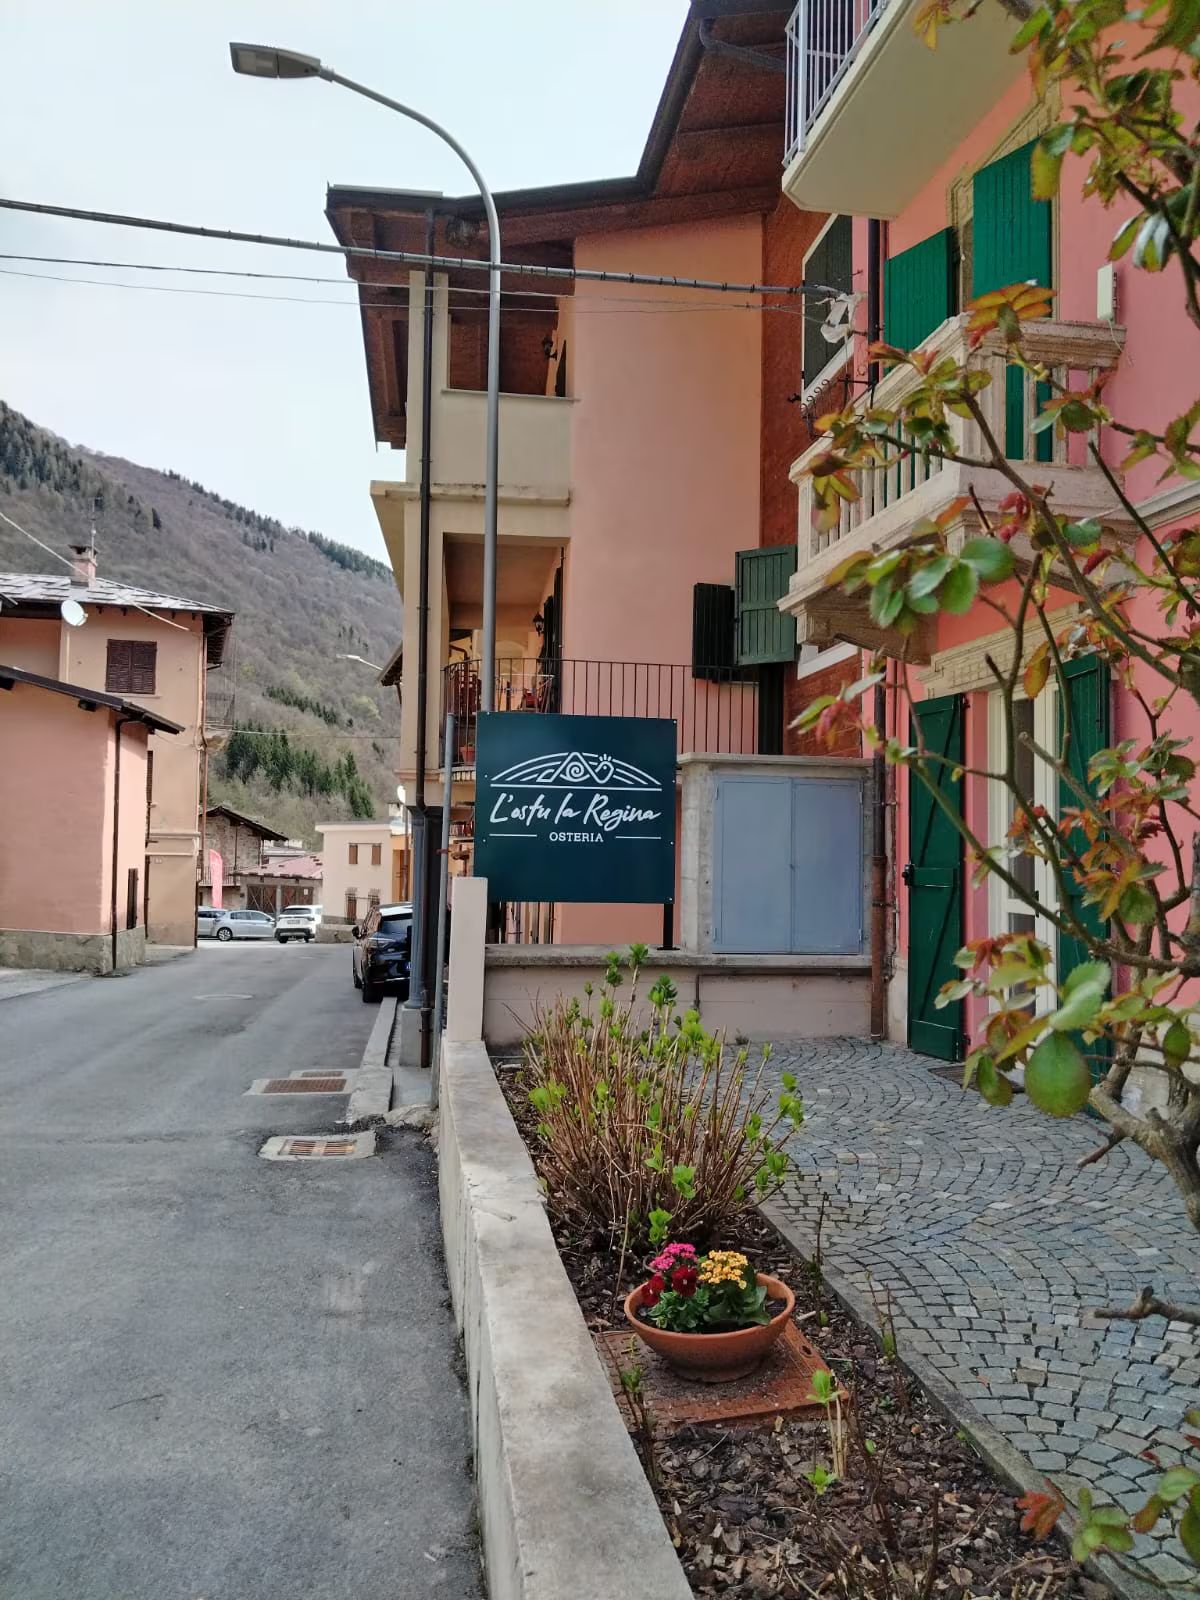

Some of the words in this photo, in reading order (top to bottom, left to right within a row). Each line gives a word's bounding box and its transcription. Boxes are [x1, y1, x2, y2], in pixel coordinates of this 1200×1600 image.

[554, 792, 581, 825] la
[583, 793, 662, 832] Regina
[549, 831, 604, 842] OSTERIA
